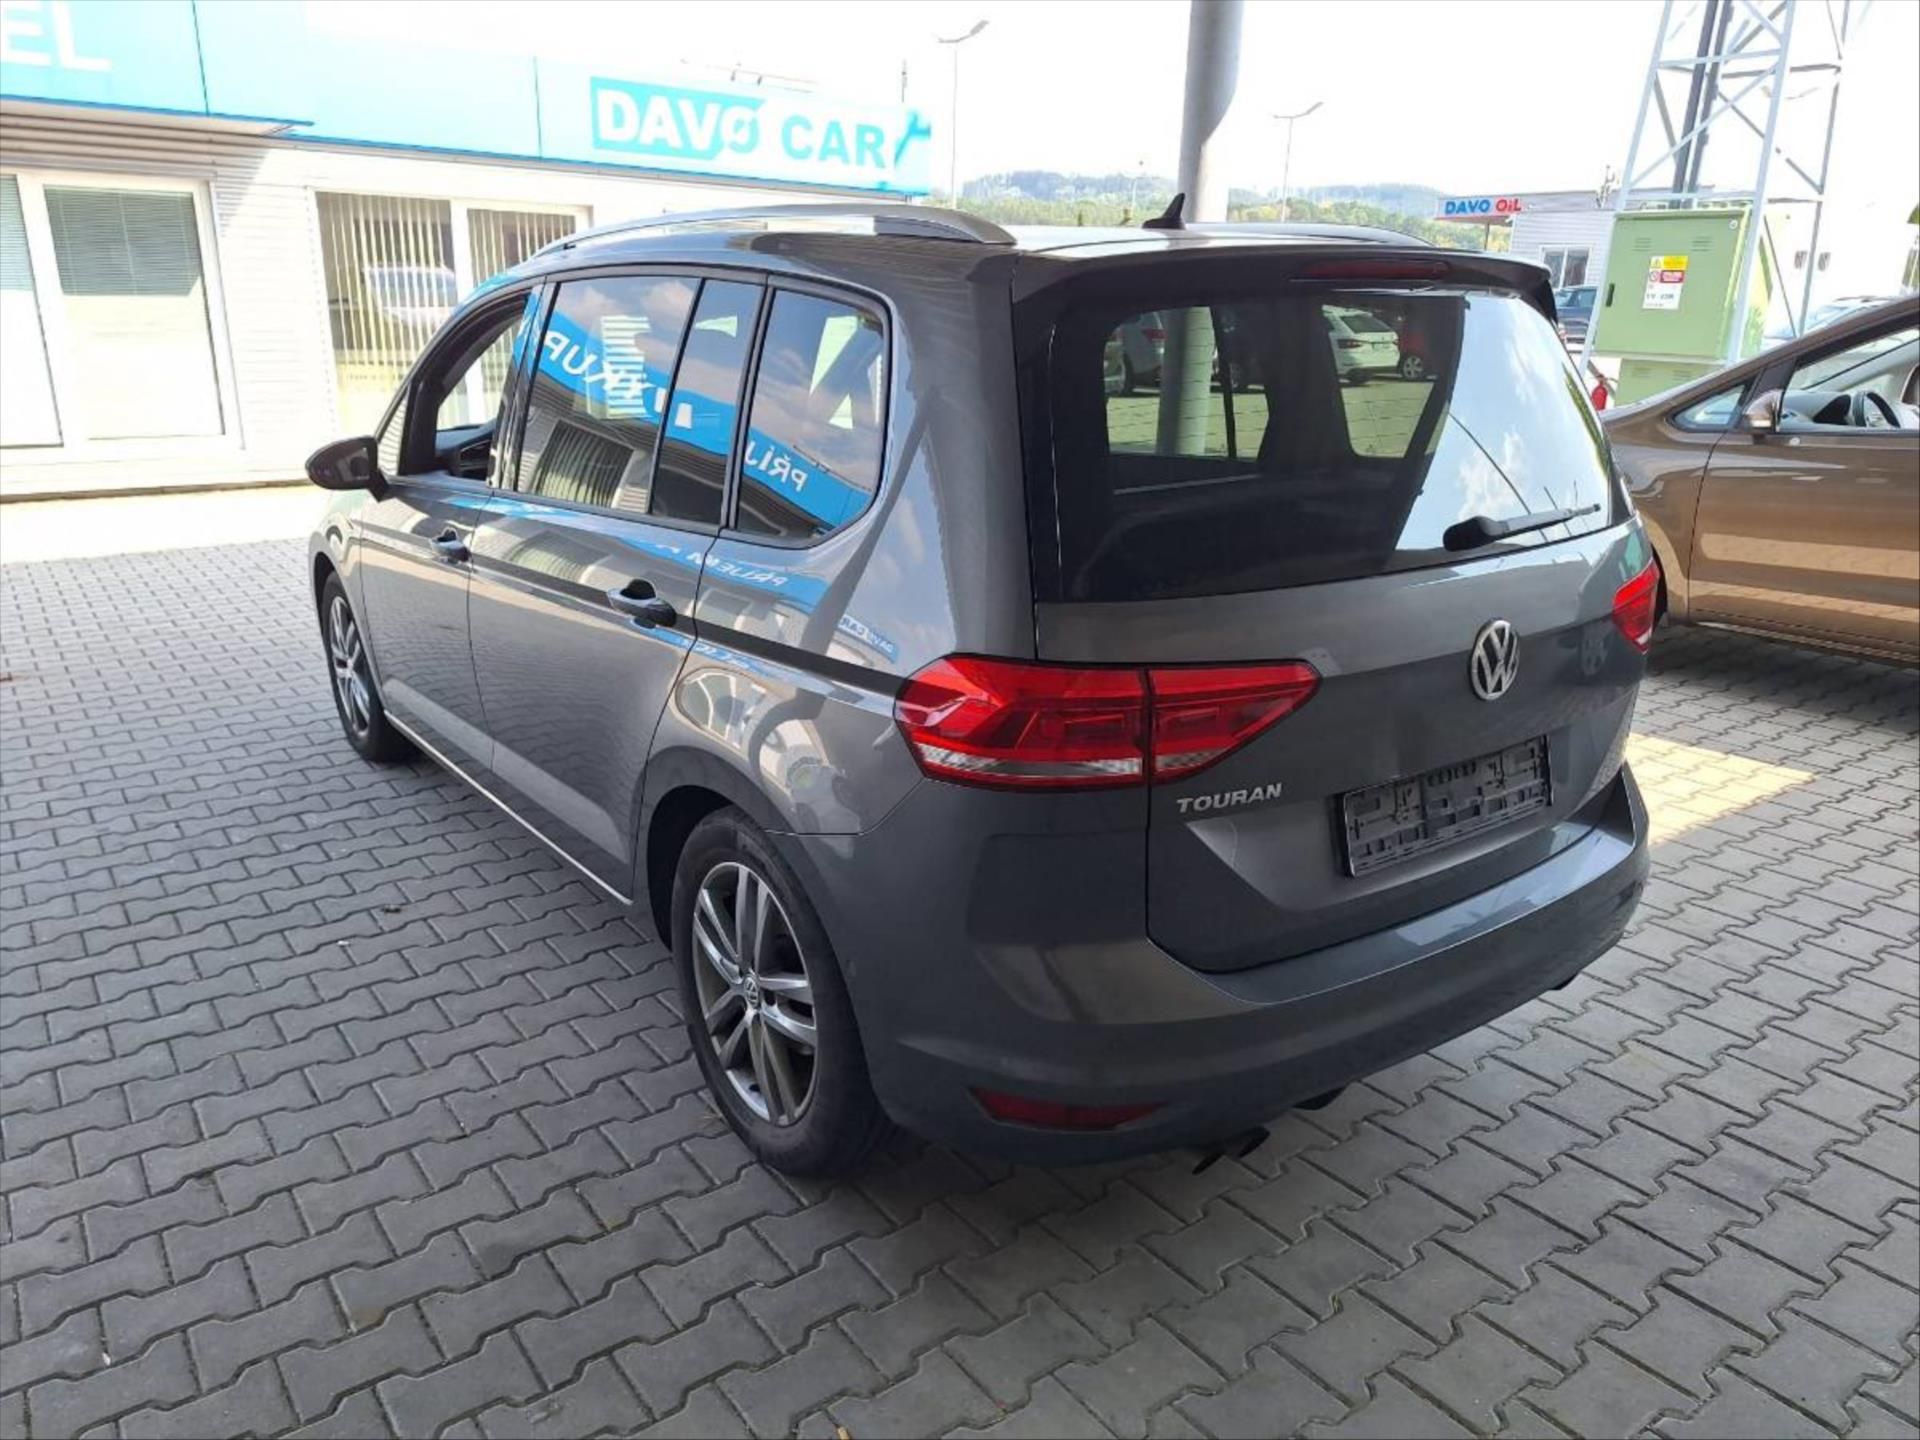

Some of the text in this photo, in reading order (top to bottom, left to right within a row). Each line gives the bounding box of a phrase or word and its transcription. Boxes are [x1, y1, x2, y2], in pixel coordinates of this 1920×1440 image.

[780, 113, 887, 168] CAR
[1445, 199, 1491, 215] DAVO
[1176, 782, 1282, 813] TOURAN
